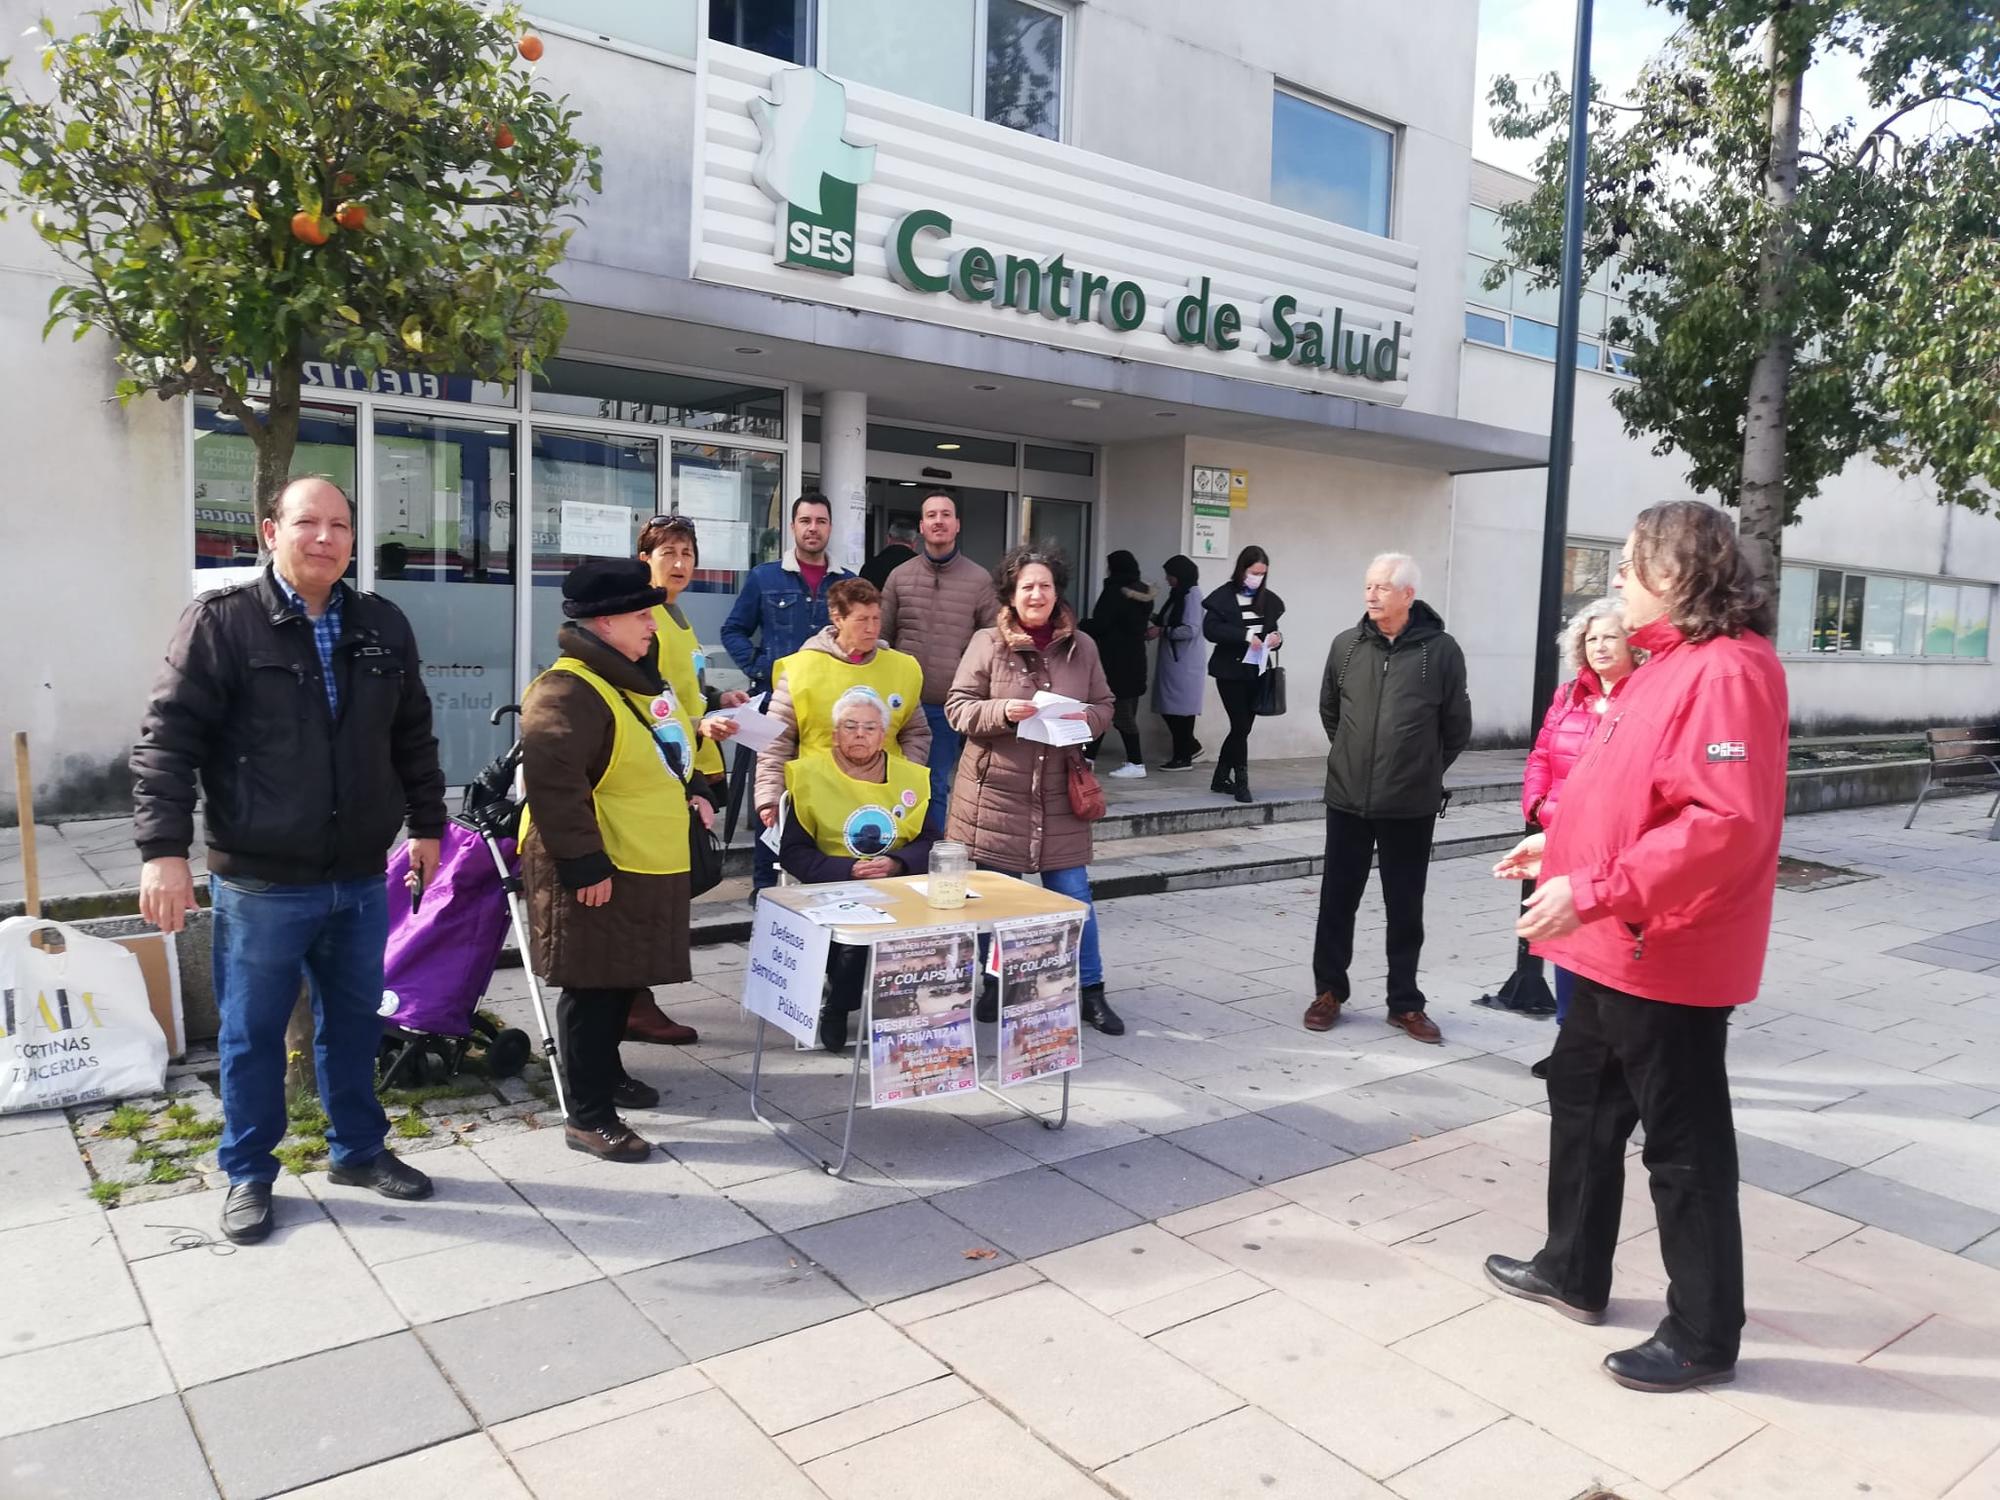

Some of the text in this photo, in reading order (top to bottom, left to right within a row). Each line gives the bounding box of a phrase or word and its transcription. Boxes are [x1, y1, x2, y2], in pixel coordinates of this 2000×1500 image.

[789, 220, 853, 264] SES
[895, 209, 1402, 381] Centro de Salud
[418, 660, 486, 678] entro
[434, 691, 493, 710] Salud
[770, 921, 805, 951] Defensa
[771, 945, 797, 971] de los
[751, 957, 788, 990] Servicios
[777, 995, 814, 1030] Públicos
[14, 1036, 91, 1060] CORTINAS
